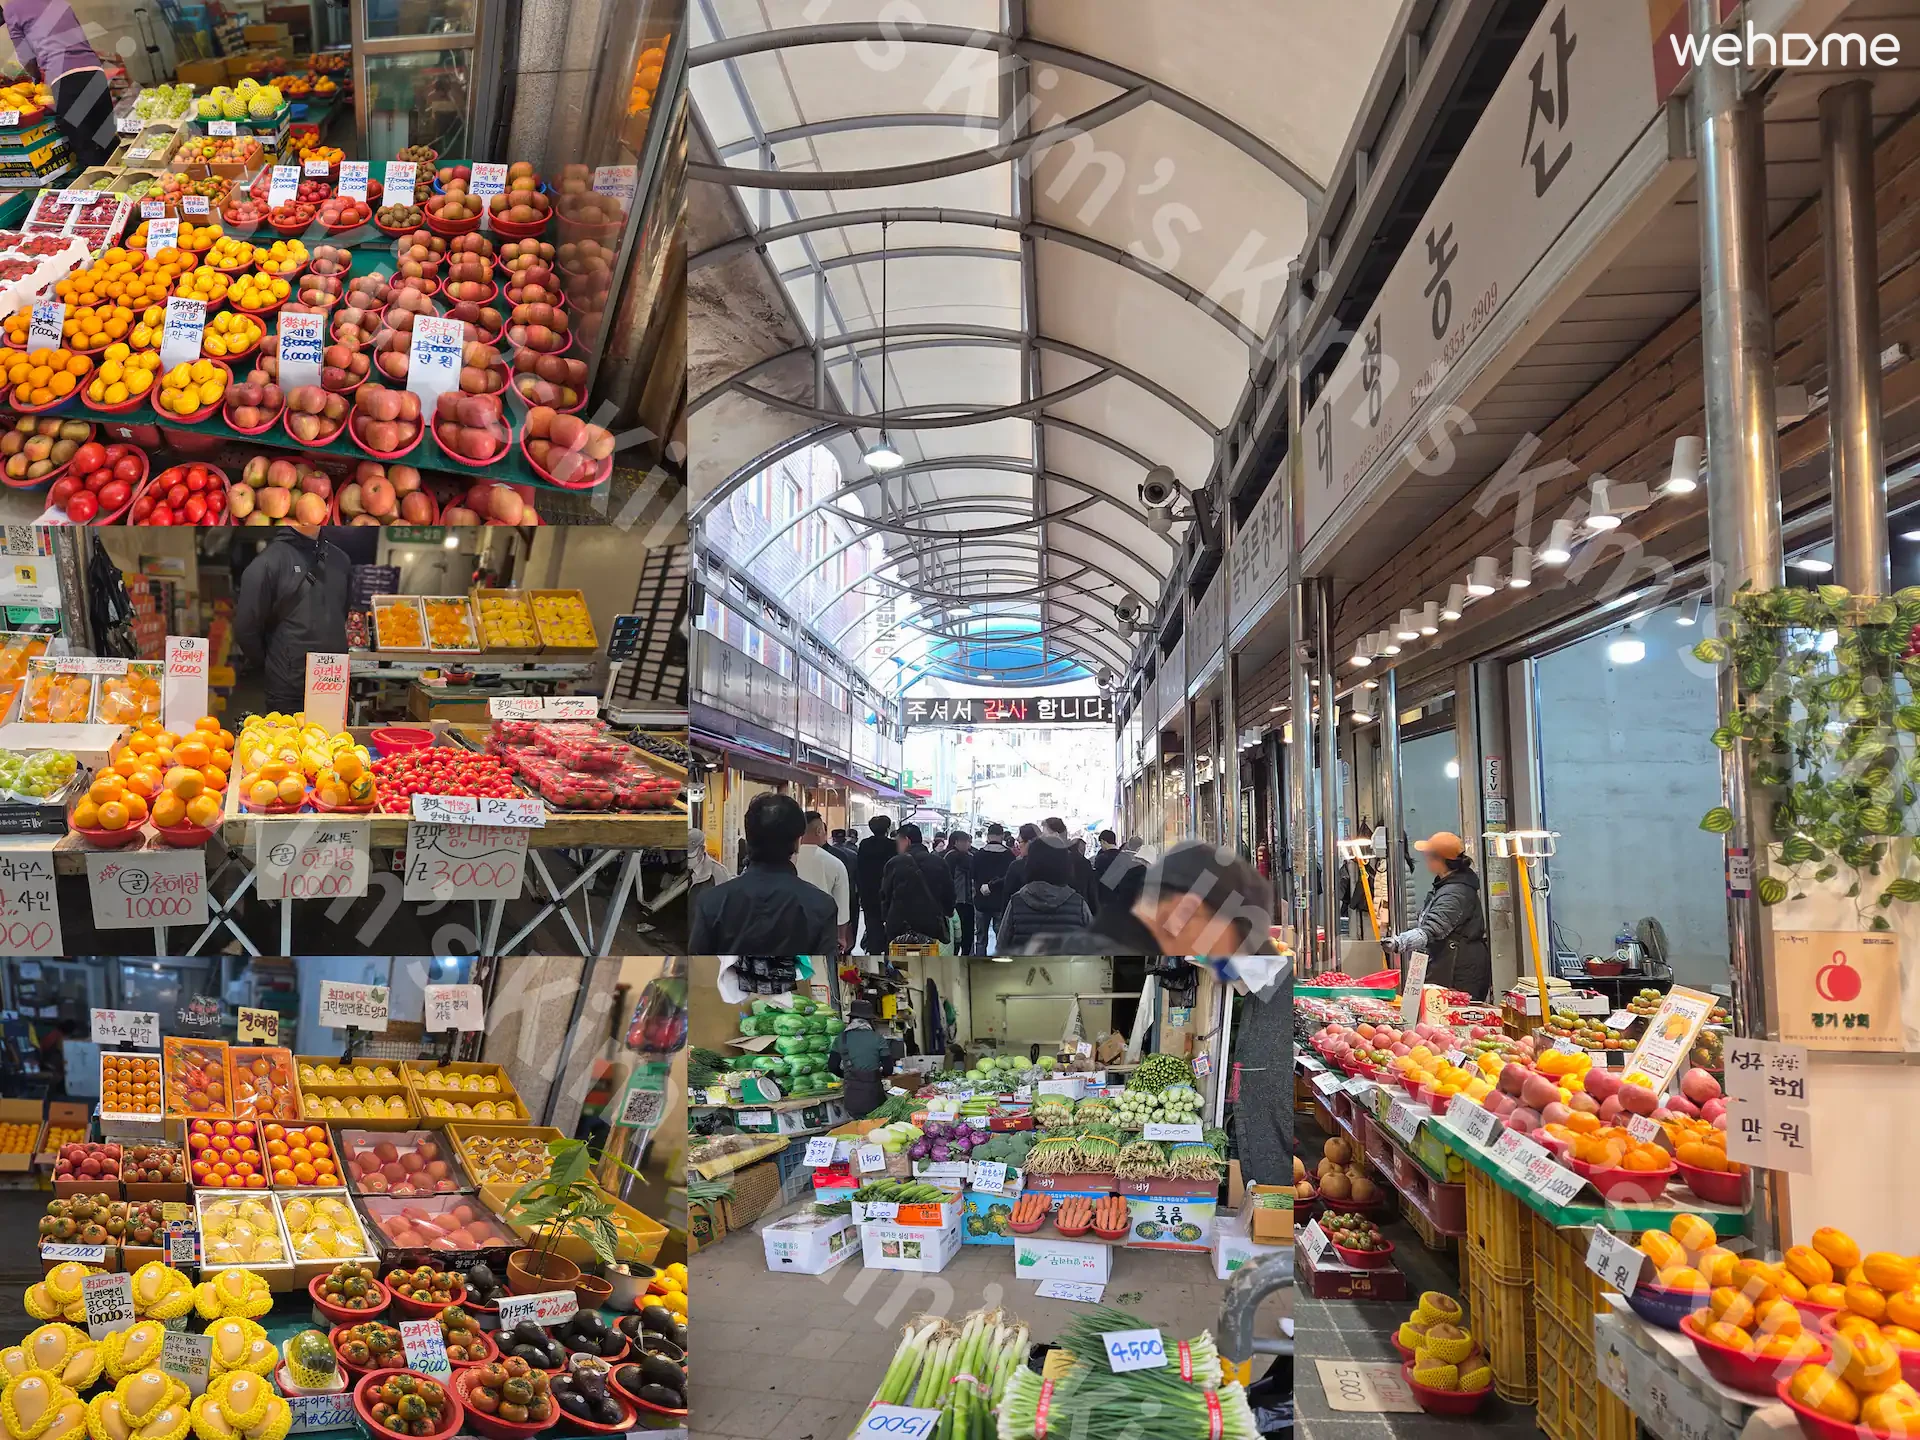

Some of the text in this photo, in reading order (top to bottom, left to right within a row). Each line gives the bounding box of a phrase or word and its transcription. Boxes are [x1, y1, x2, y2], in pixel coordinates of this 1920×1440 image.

[418, 354, 454, 368] 만 원
[172, 647, 204, 664] 천혜향
[907, 701, 972, 722] 주셔서
[984, 699, 1027, 721] 감사
[1490, 761, 1498, 791] CCTV
[412, 825, 446, 851] 꿀맛
[302, 845, 355, 871] 한라봉
[150, 870, 204, 897] 천혜향
[18, 890, 51, 912] 샤인
[95, 1011, 117, 1022] 제주
[1811, 1012, 1870, 1030] 경기 상회
[99, 1025, 127, 1037] 하우스
[1731, 1050, 1765, 1071] 성주
[1768, 1076, 1805, 1100] 참외
[1741, 1117, 1805, 1149] 만 원
[1597, 1254, 1630, 1293] 만 원
[501, 1303, 536, 1320] 아보카도
